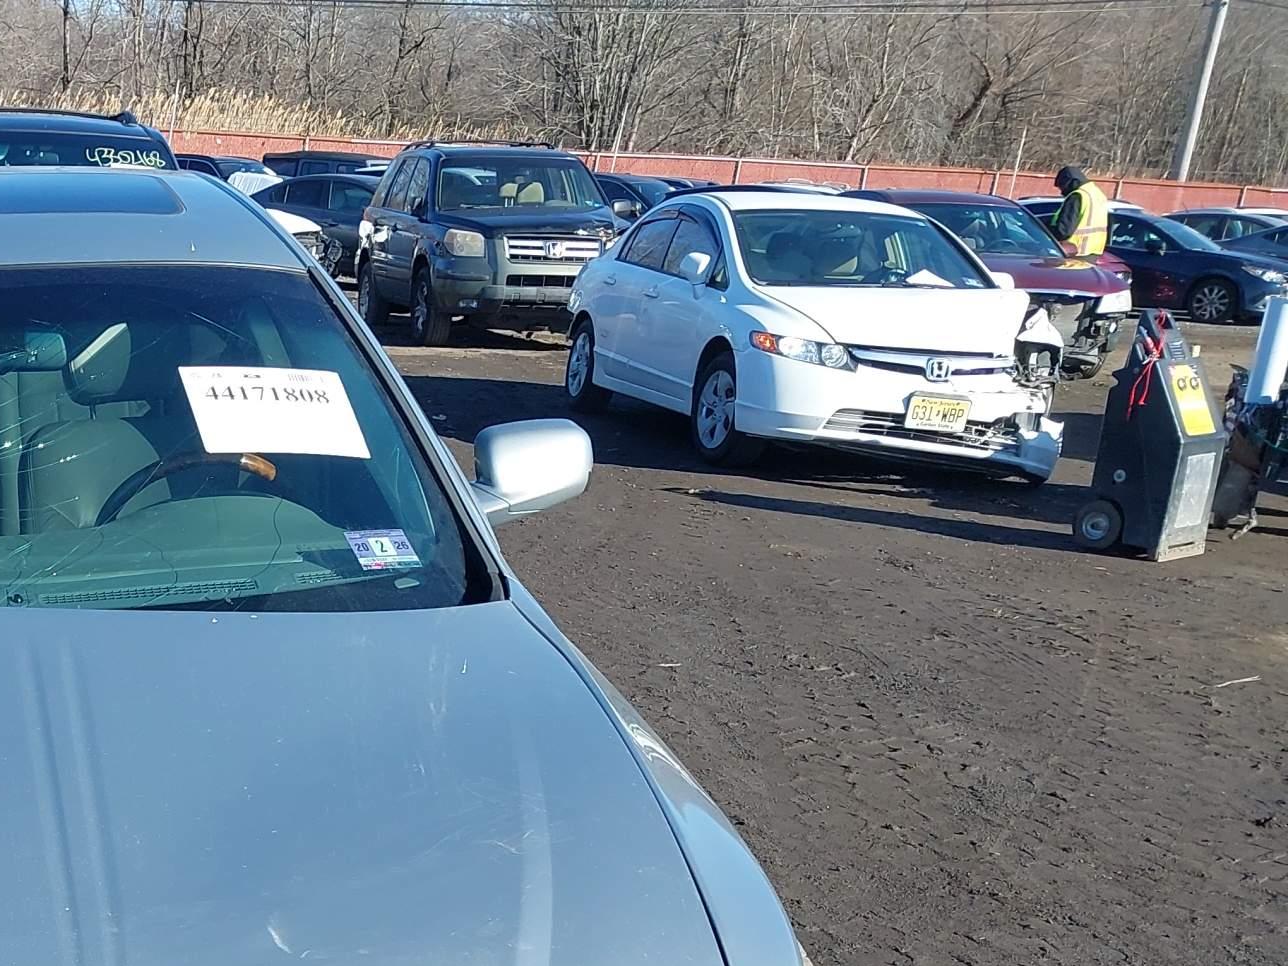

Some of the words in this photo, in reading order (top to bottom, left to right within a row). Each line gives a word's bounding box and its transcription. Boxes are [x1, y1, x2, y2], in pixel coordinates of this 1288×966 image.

[205, 386, 330, 404] 44171808
[354, 543, 370, 552] 20
[375, 540, 388, 553] 2
[393, 541, 409, 550] 26
